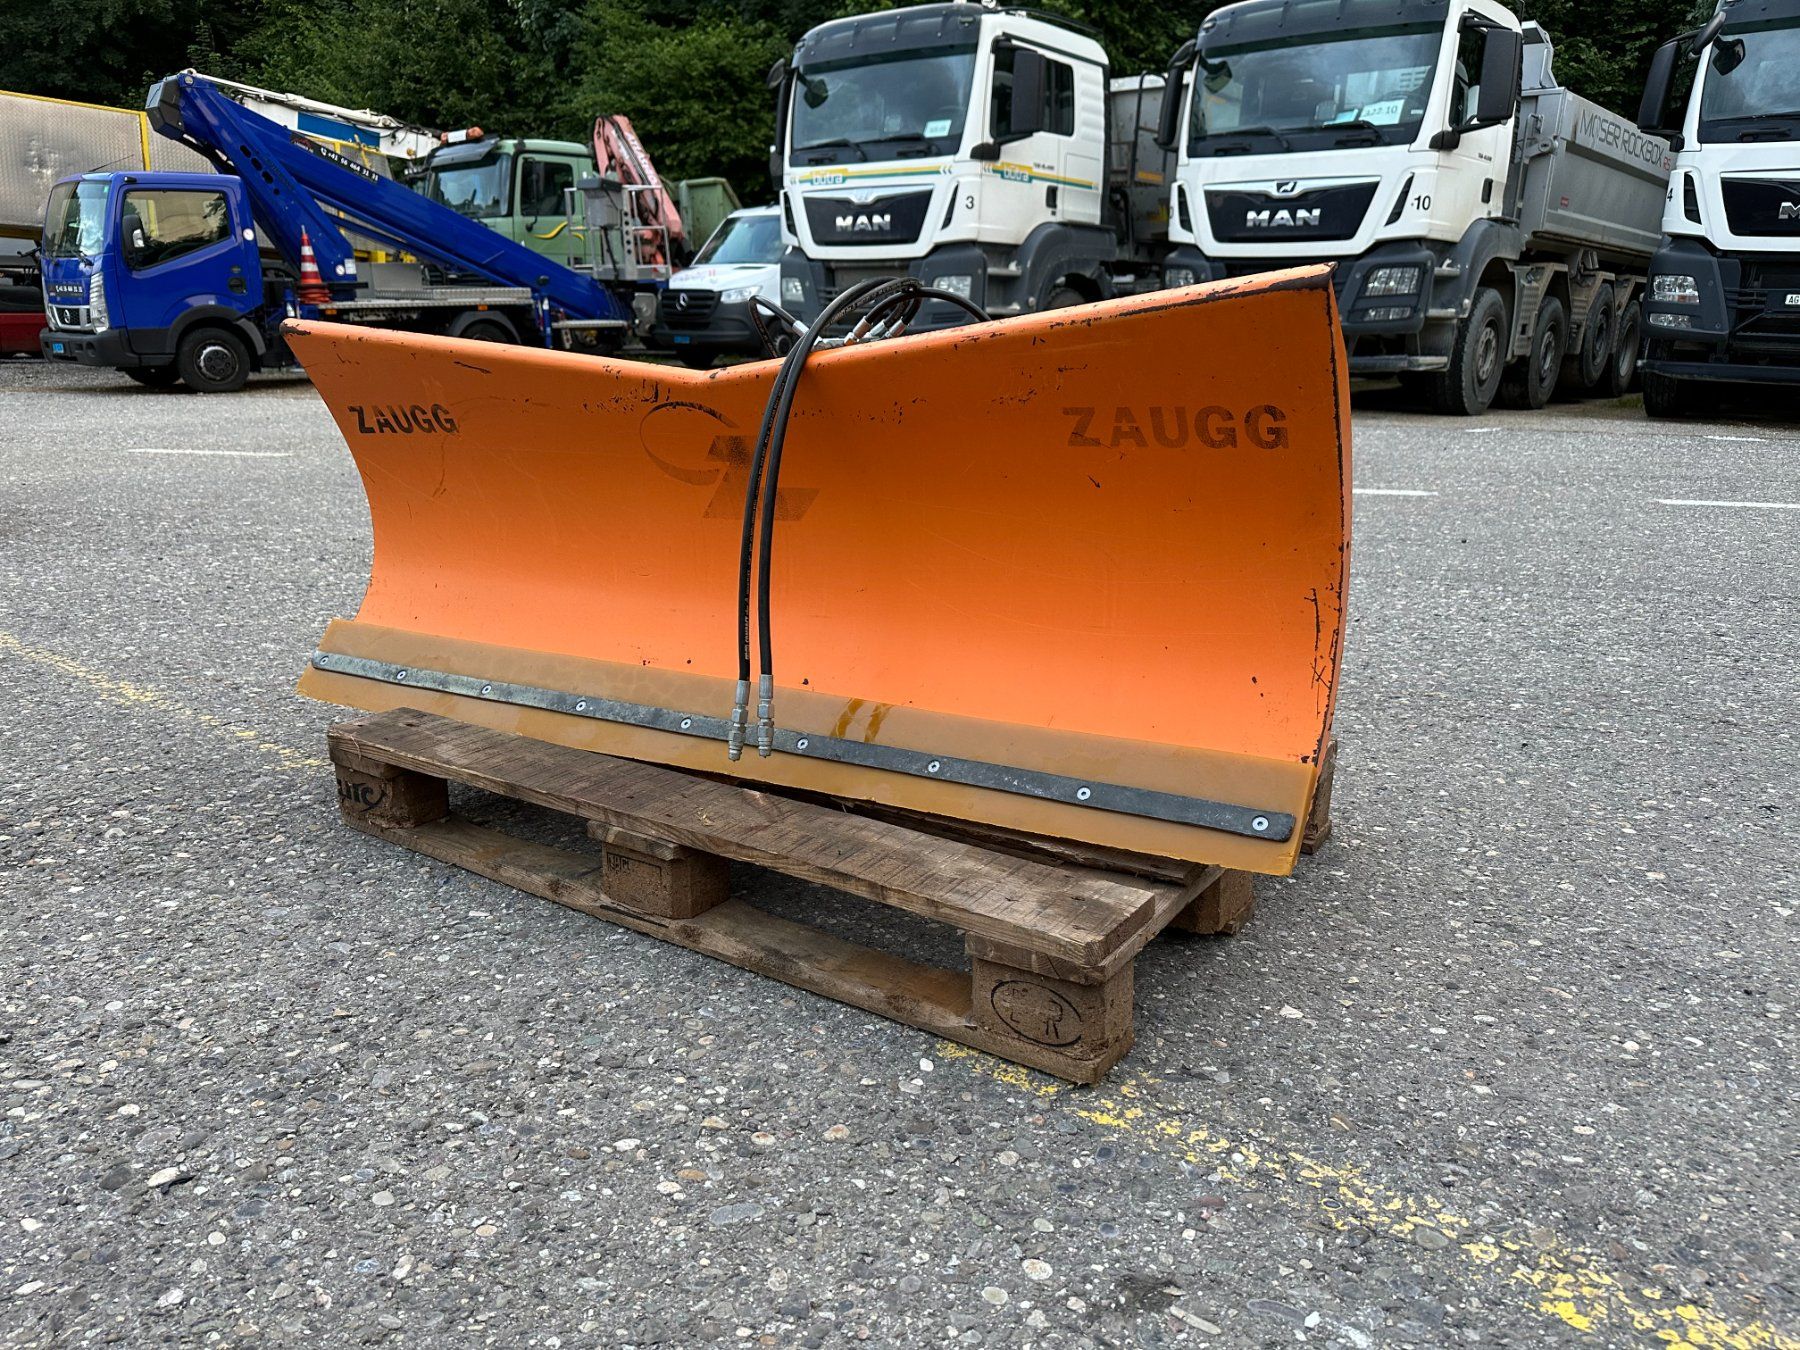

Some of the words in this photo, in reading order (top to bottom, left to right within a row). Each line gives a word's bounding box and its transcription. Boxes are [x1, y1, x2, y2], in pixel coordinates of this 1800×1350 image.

[1580, 109, 1621, 149] MOSER
[1619, 128, 1665, 168] ROCKBOX
[965, 195, 975, 210] 3
[1414, 195, 1431, 211] 10
[1666, 188, 1674, 202] 4
[835, 213, 892, 232] MAN
[1246, 208, 1321, 228] MAN
[348, 403, 460, 435] ZAUGG
[1062, 404, 1290, 450] ZAUGG
